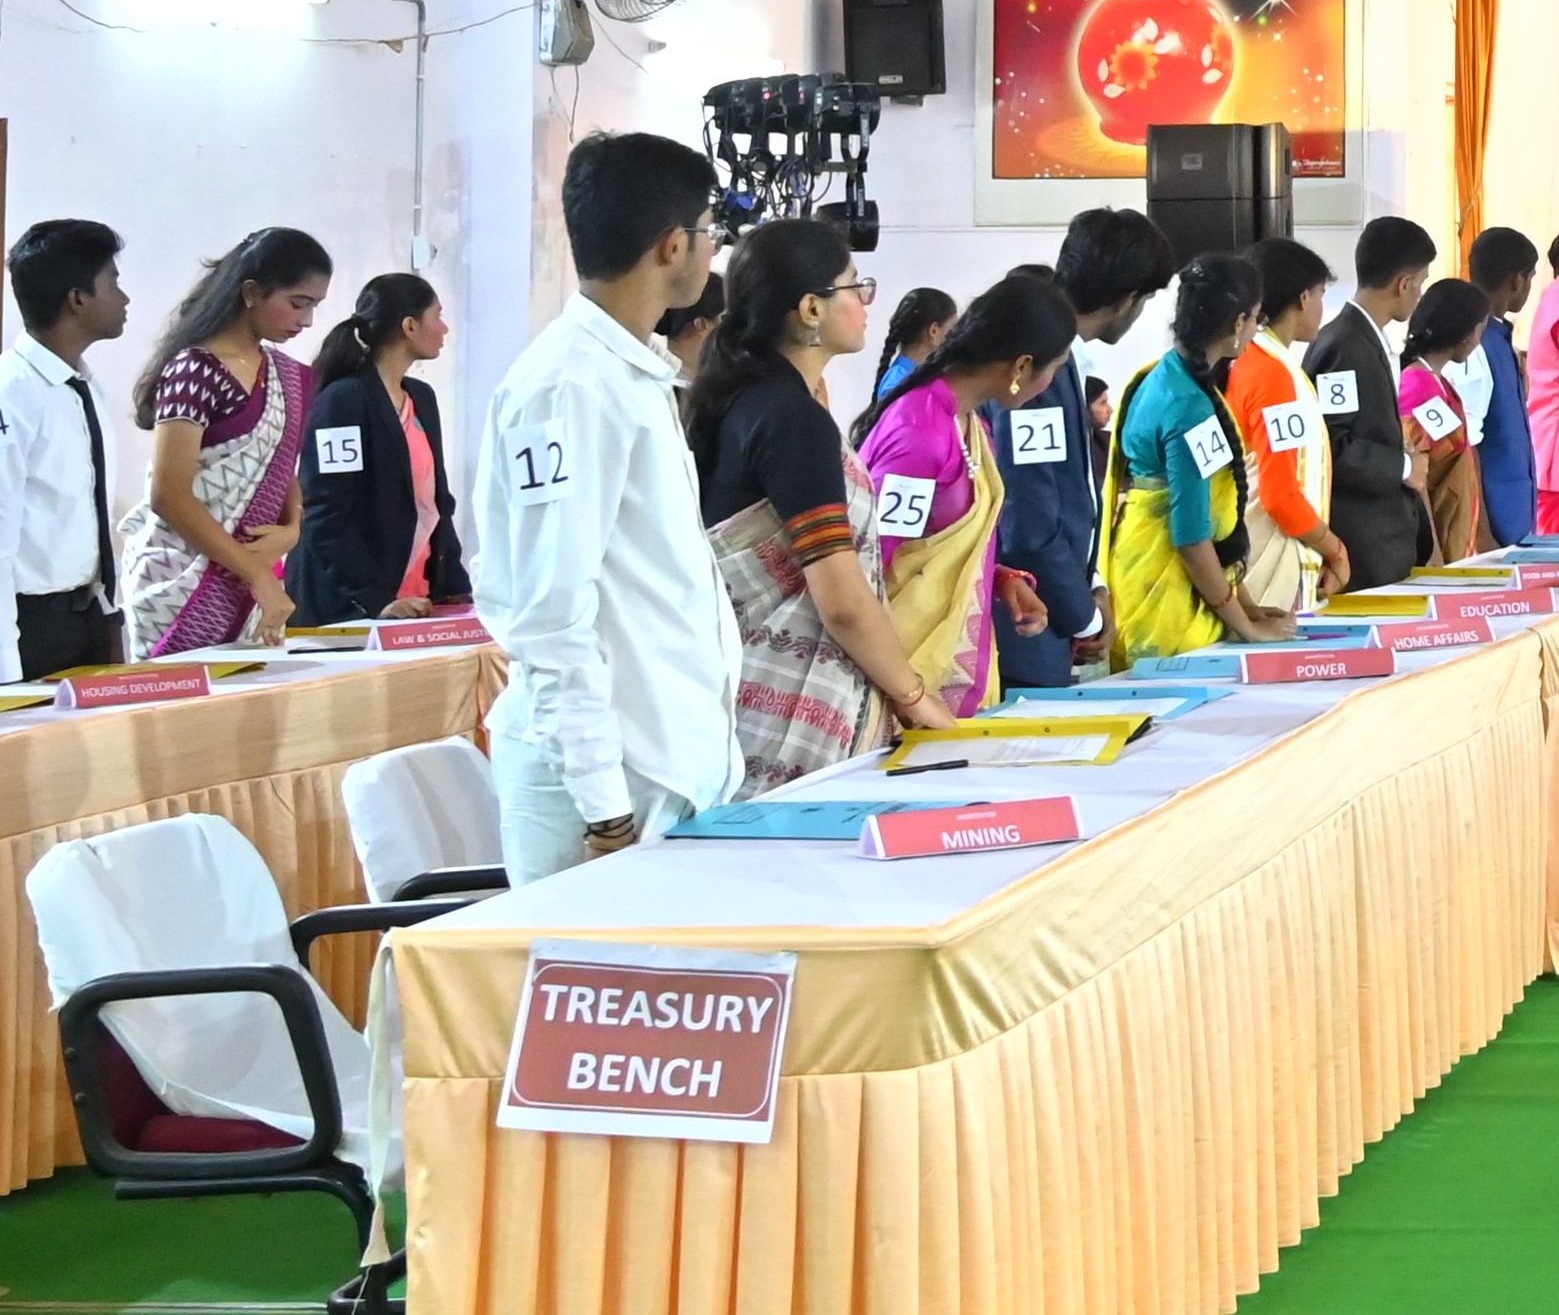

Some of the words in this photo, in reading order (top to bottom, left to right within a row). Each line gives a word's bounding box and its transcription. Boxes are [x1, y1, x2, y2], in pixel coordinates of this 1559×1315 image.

[1330, 383, 1346, 406] 8
[1268, 413, 1306, 442] 10
[1425, 408, 1444, 428] 9
[1016, 425, 1061, 452] 21
[1195, 429, 1226, 468] 14
[322, 439, 359, 464] 15
[514, 441, 569, 491] 12
[879, 491, 927, 529] 25
[1460, 601, 1530, 618] EDUCATION
[392, 636, 415, 645] LAW
[427, 631, 462, 642] SOCIAL
[1394, 635, 1431, 650] HOME
[1433, 629, 1480, 645] AFFAIRS
[1296, 662, 1347, 677] POWER
[81, 684, 129, 697] HOUSING
[129, 678, 201, 694] DEVELOPMENT
[941, 824, 1021, 850] MINING
[539, 982, 774, 1035] TREASURY
[566, 1051, 724, 1098] BENCH
